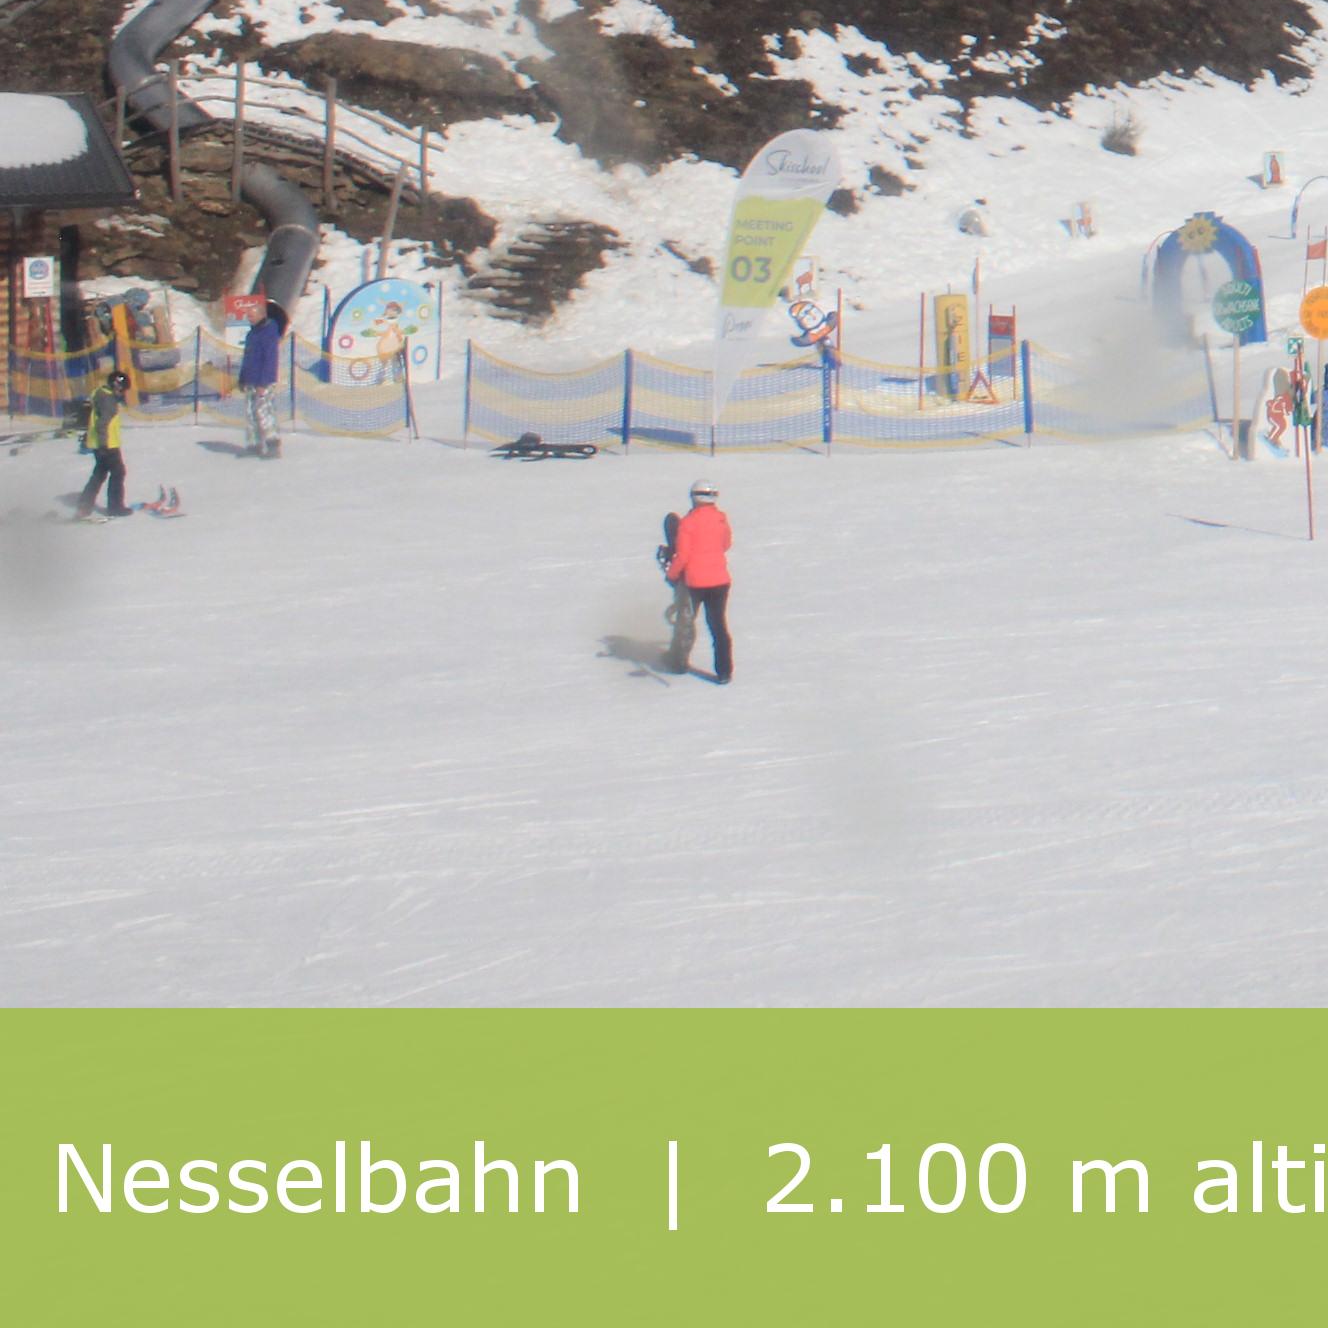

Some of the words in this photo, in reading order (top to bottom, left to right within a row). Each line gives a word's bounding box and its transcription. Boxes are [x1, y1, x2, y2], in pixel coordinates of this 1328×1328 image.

[735, 221, 794, 233] MEETING
[735, 236, 776, 247] POINT
[731, 255, 773, 284] 03
